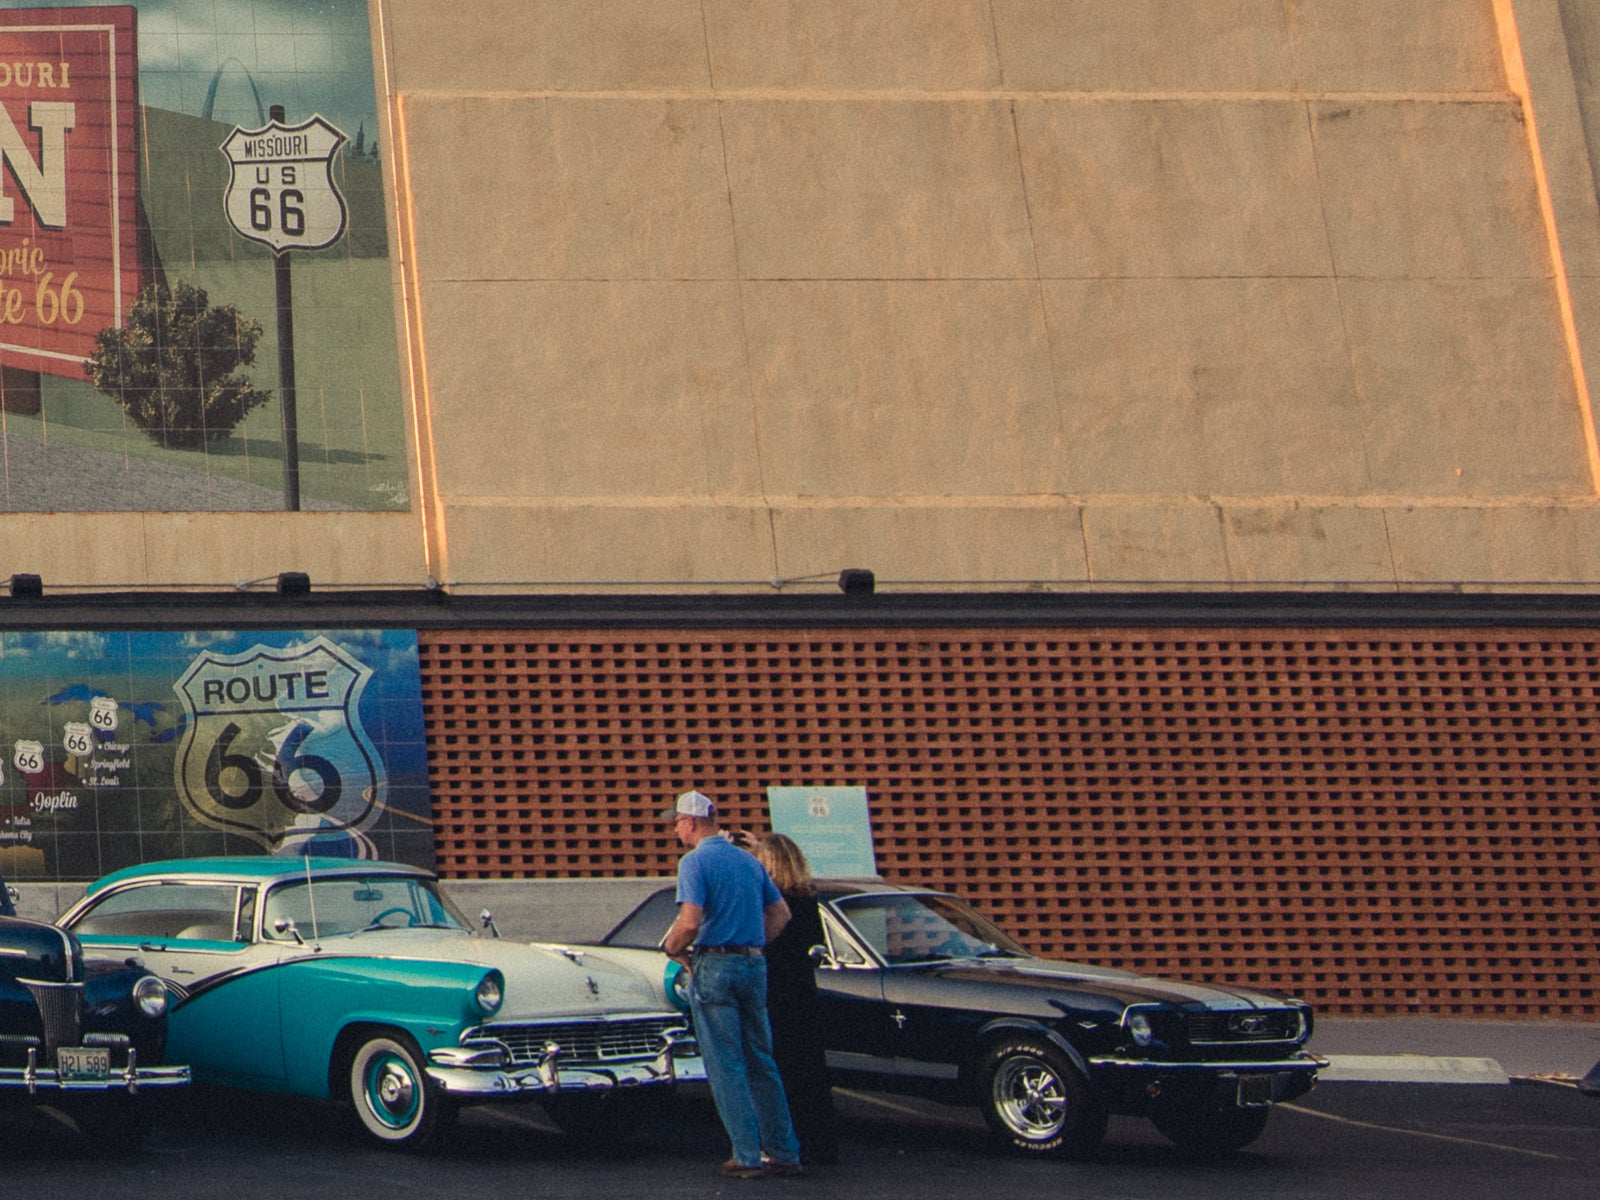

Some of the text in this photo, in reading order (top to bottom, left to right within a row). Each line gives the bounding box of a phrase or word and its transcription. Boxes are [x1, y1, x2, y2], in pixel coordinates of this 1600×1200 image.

[244, 135, 309, 159] MISSOURI
[250, 188, 305, 236] 66
[36, 272, 85, 324] 66
[204, 670, 329, 704] ROUTE
[94, 710, 113, 726] 66
[68, 735, 87, 751] 66
[19, 753, 38, 769] 66
[205, 721, 342, 814] 66
[35, 791, 78, 813] Joplin
[61, 1055, 107, 1073] H21 589
